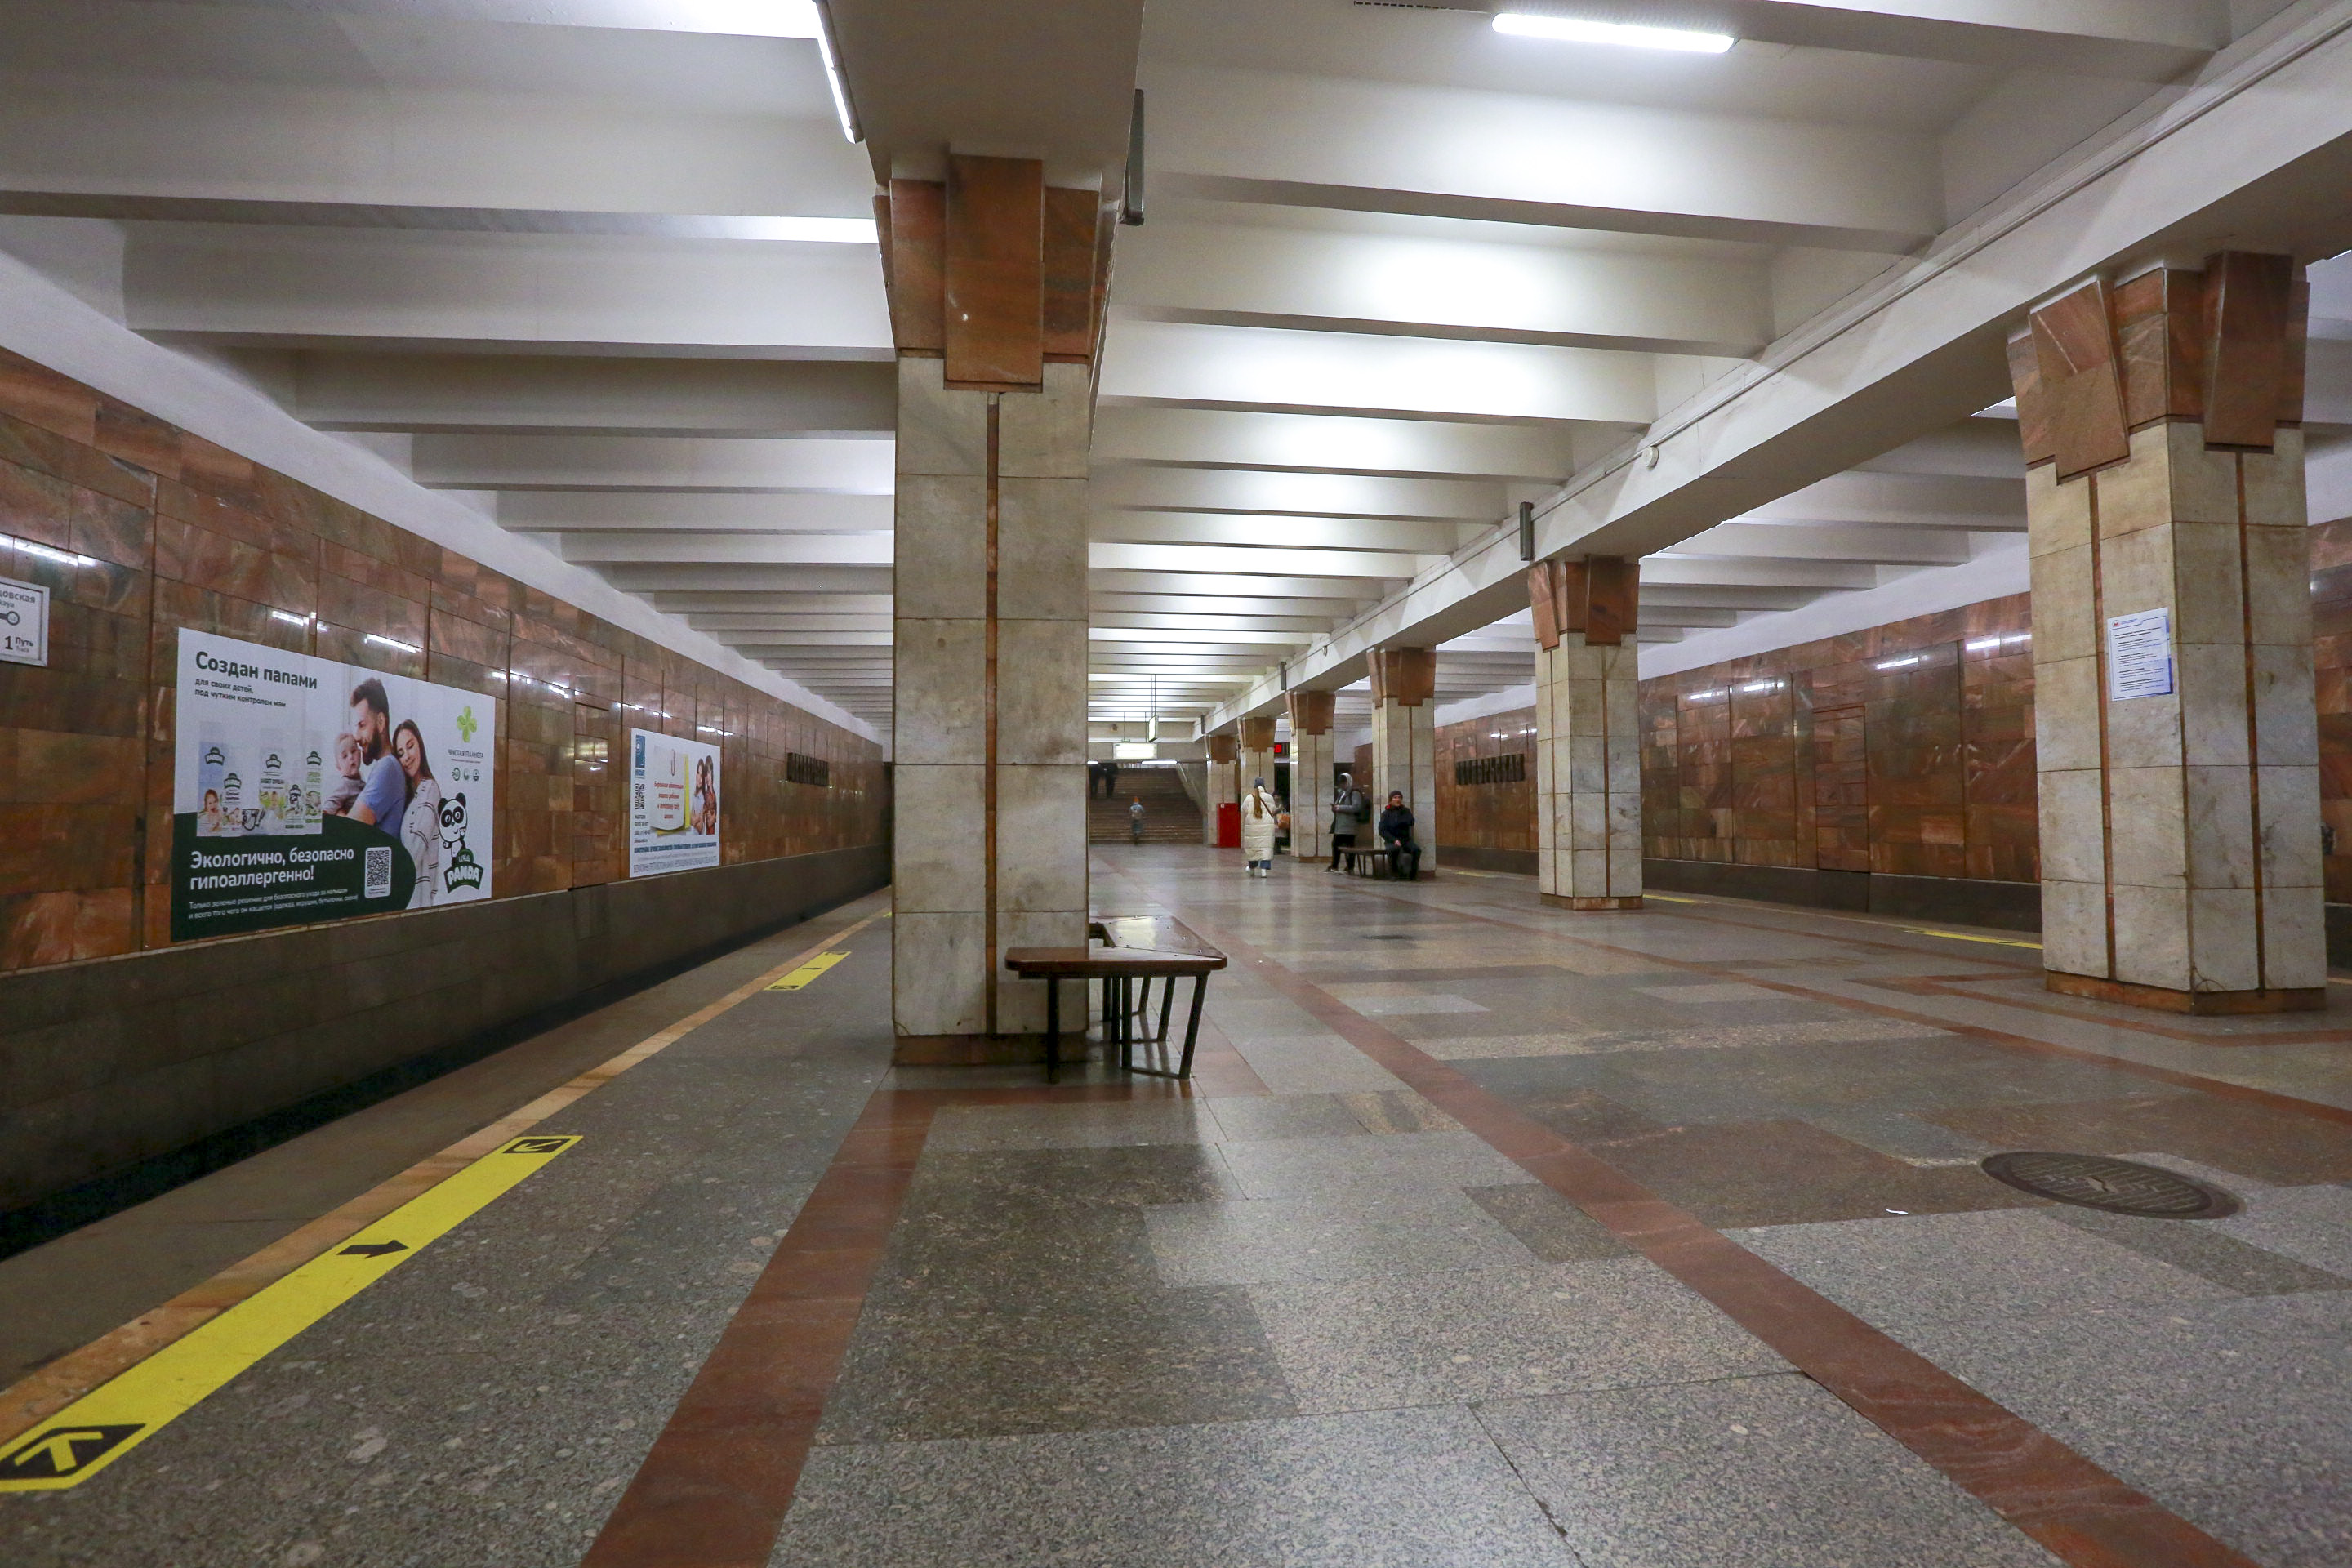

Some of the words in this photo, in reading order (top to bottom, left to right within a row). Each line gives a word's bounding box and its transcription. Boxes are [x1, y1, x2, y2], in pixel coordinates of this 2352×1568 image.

[5, 635, 13, 650] 1
[15, 637, 34, 647] Путь
[195, 650, 259, 679] Создан
[263, 668, 318, 689] папами
[194, 688, 209, 697] под
[211, 692, 236, 701] чутким
[210, 680, 231, 690] своих
[190, 850, 286, 869] Экологично,
[289, 846, 354, 863] безопасно
[189, 864, 314, 890] гипоаллергенно!
[447, 865, 479, 885] PANDA
